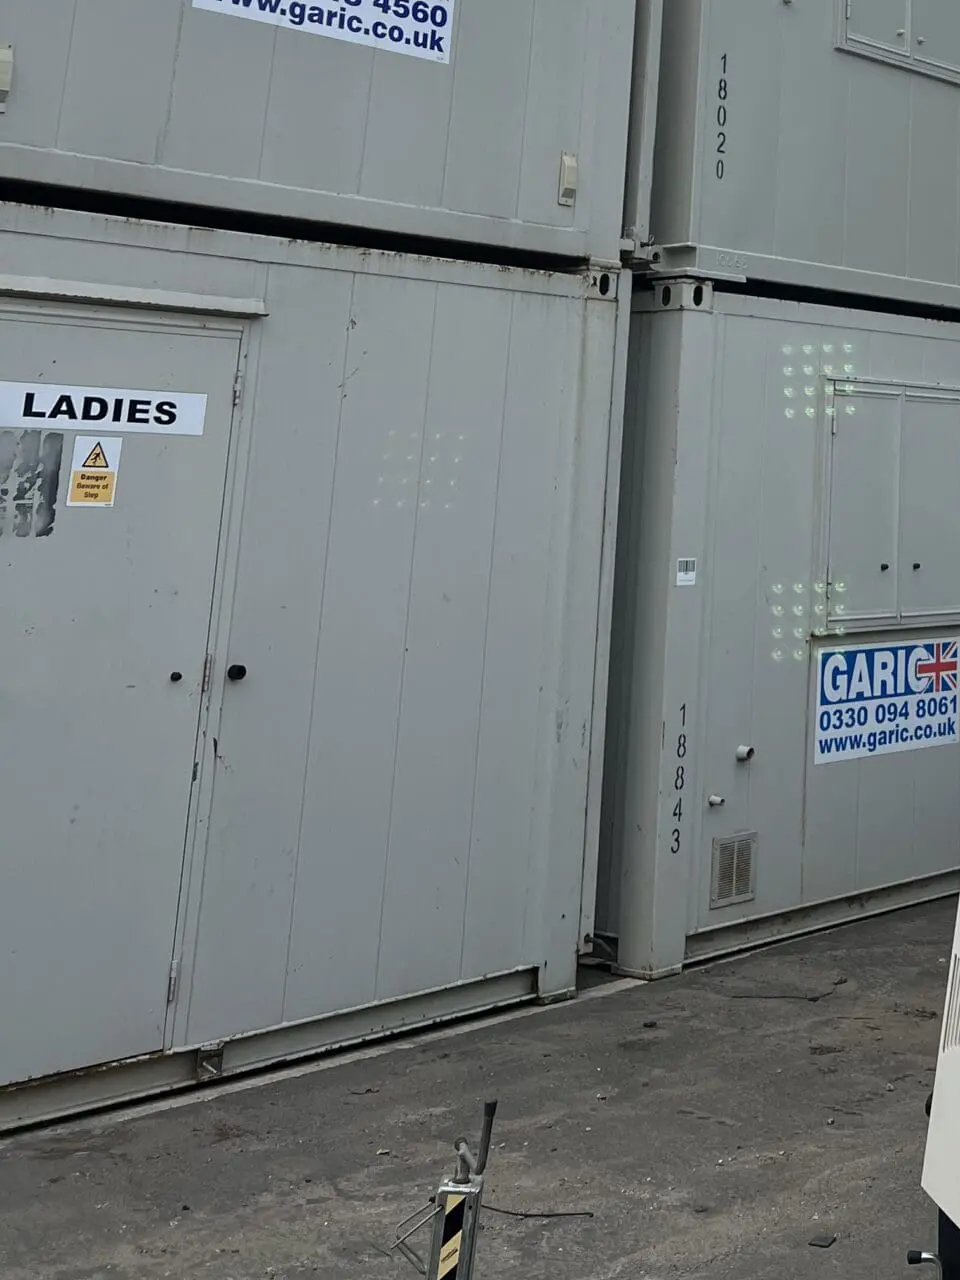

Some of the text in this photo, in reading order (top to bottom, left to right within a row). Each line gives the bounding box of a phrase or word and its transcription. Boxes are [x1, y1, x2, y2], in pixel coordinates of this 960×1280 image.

[716, 53, 728, 179] 18020
[22, 392, 178, 426] LADIES
[80, 473, 108, 481] Danger
[823, 647, 932, 703] GARIC
[819, 694, 957, 732] 0330 094 8061
[819, 717, 956, 755] www.garic.co.uk
[670, 703, 687, 854] 18843
